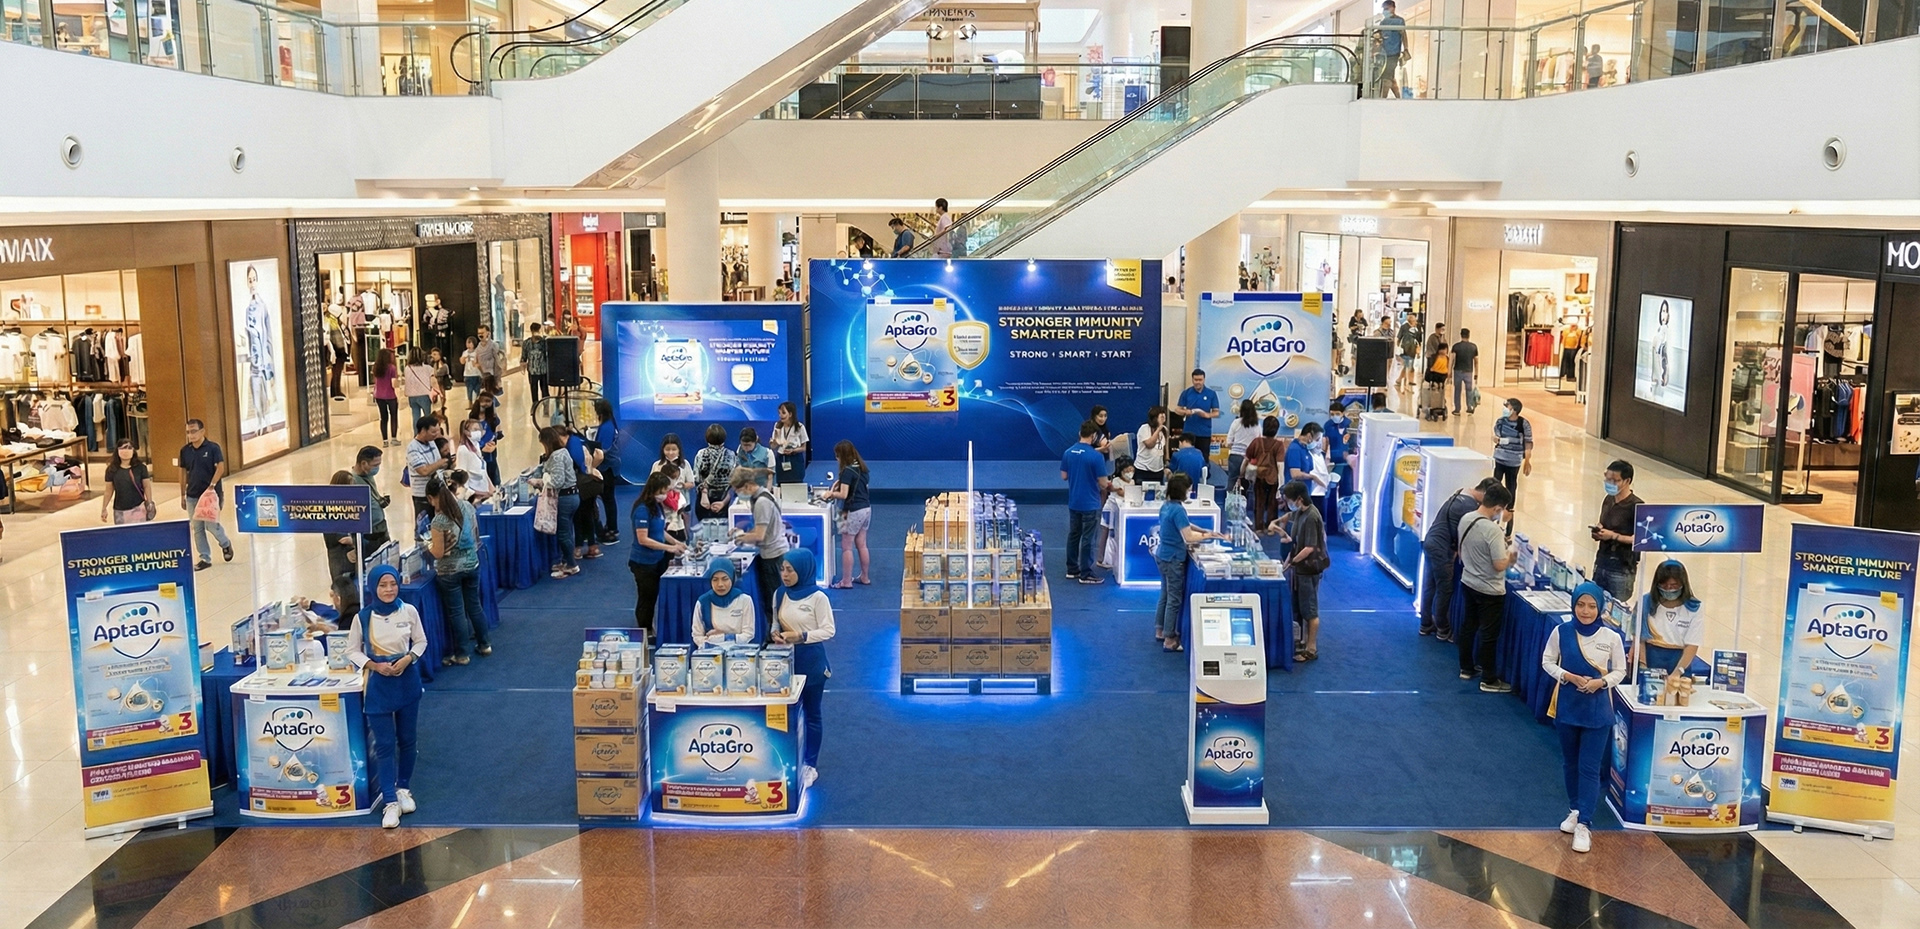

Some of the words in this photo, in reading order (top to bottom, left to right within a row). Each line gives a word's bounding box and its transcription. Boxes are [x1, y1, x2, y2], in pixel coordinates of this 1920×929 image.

[998, 316, 1072, 327] STRONGER
[1075, 316, 1143, 327] IMMUNITY
[884, 324, 938, 338] AptaGro
[1010, 329, 1074, 340] SMARTER
[1078, 329, 1132, 340] FUTURE
[1058, 350, 1091, 359] SMART
[1101, 350, 1132, 359] START
[1226, 336, 1306, 356] AptaGro
[943, 389, 956, 406] 3
[1674, 521, 1725, 534] AptaGro
[67, 554, 129, 569] STRONGER
[131, 548, 186, 563] IMMUNITY
[135, 559, 179, 572] FUTURE
[1794, 551, 1853, 566] STRONGER
[1855, 557, 1912, 571] IMMUNITY
[1802, 562, 1855, 576] SMARTER
[1857, 567, 1902, 580] FUTURE
[93, 619, 175, 643] AptaGro
[1806, 618, 1888, 642] AptaGro
[178, 712, 193, 731] 3
[262, 721, 326, 738] AptaGro
[1874, 727, 1890, 745] 3
[688, 738, 754, 756] AptaGro
[1204, 747, 1254, 760] AptaGro
[1669, 740, 1730, 757] AptaGro
[335, 785, 351, 804] 3
[766, 782, 784, 804] 3
[1724, 804, 1738, 821] 3
